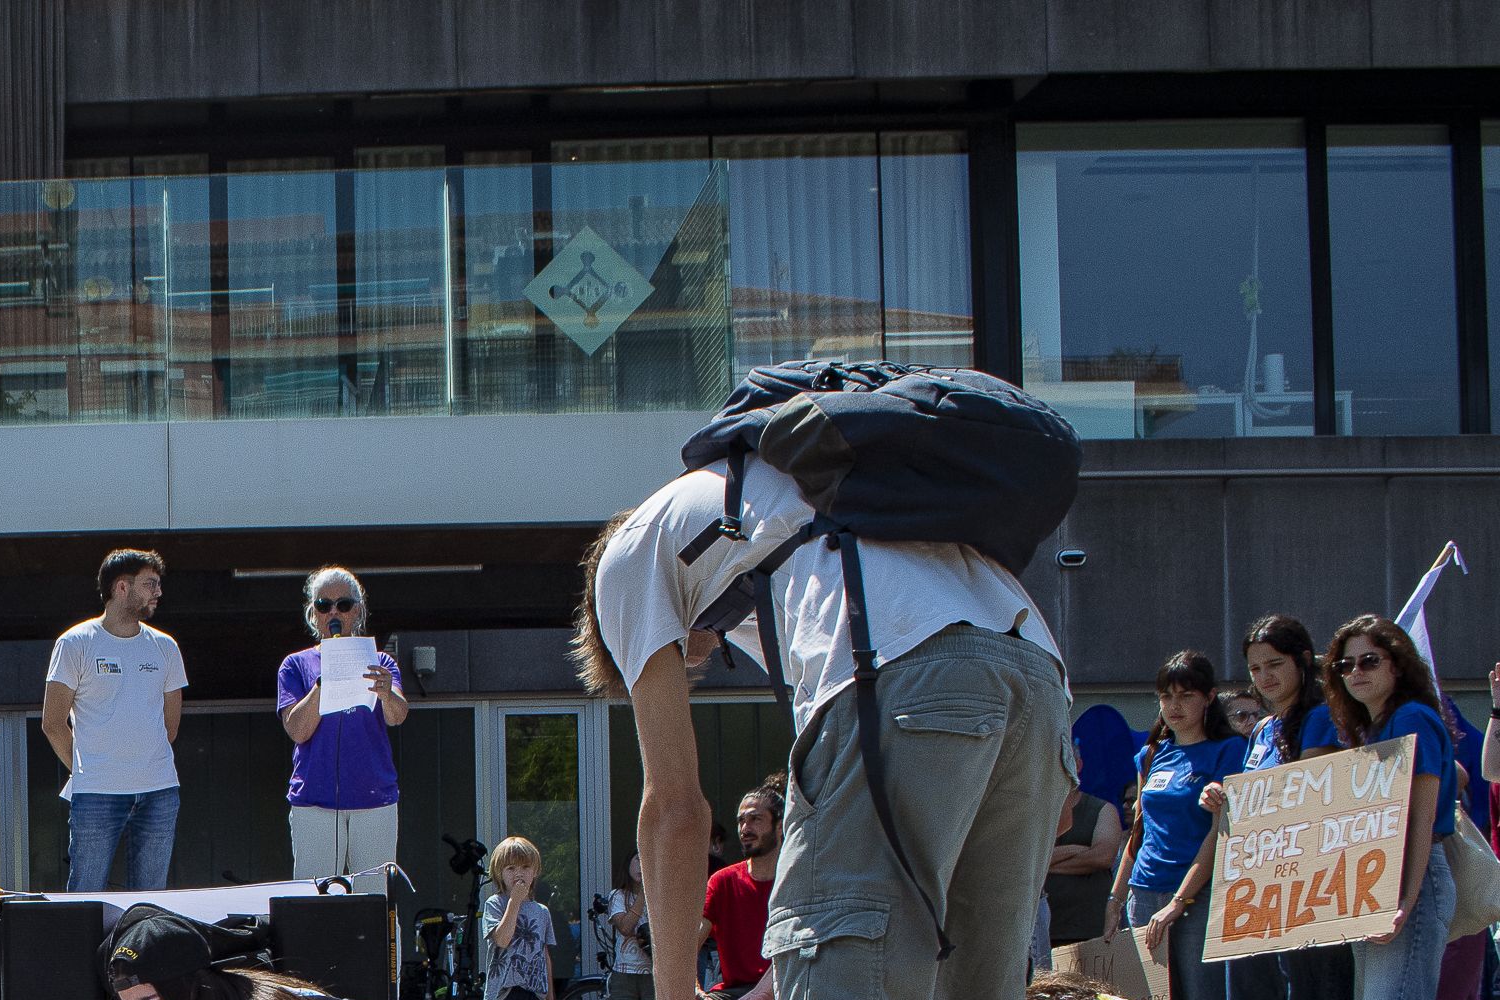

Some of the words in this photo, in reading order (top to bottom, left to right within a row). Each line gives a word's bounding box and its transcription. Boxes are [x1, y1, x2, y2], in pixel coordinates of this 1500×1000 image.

[1226, 761, 1334, 825] VOLEM
[1350, 755, 1403, 803] UN
[1222, 821, 1312, 882] ESPAI
[1319, 804, 1402, 854] DIGNE
[1274, 861, 1299, 879] PER
[1221, 848, 1387, 943] BALLAR
